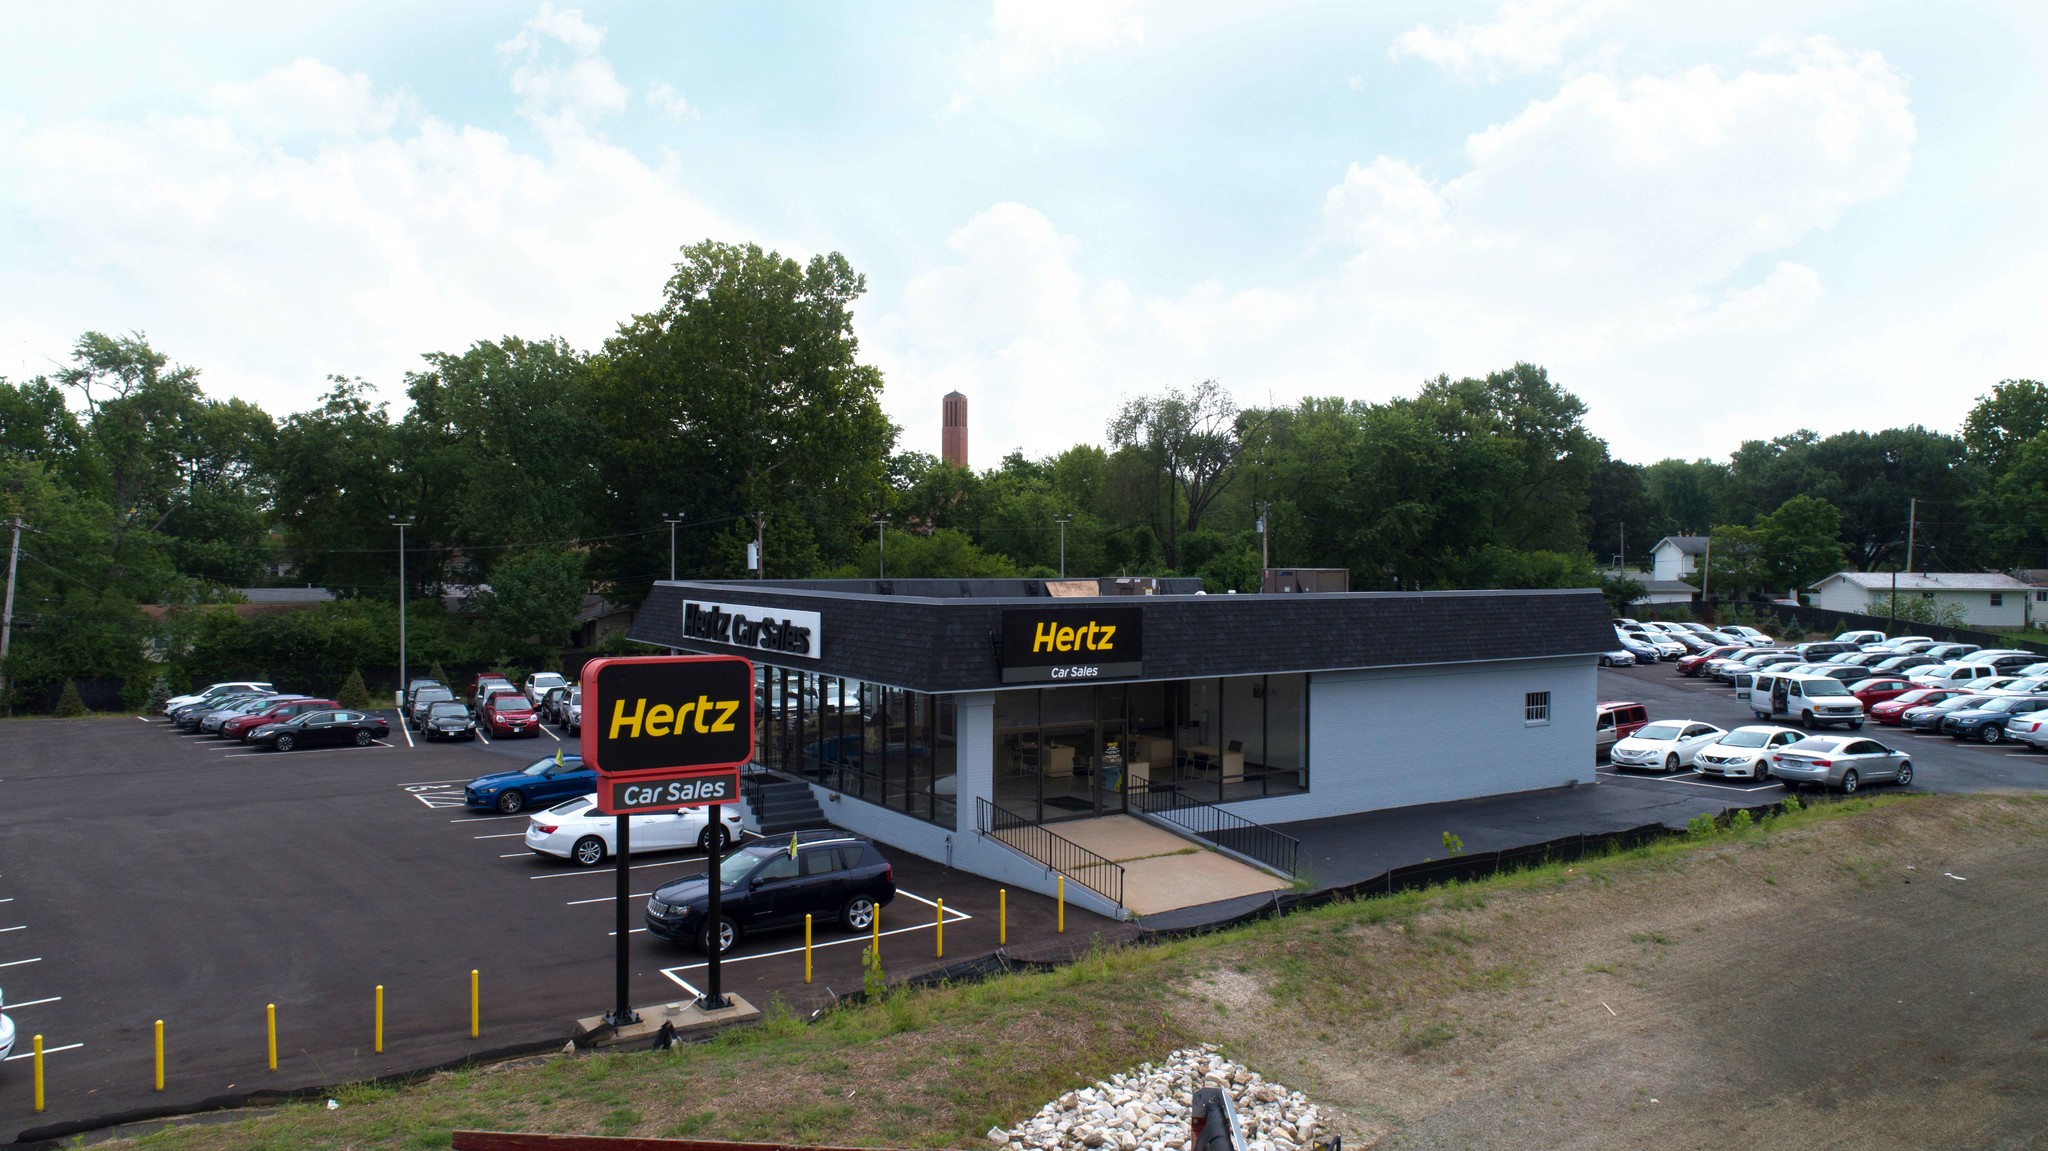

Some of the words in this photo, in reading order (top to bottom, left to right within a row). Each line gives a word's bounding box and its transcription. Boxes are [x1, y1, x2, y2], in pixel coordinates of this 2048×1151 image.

[686, 603, 732, 642] Hertz
[732, 613, 762, 647] Car
[759, 617, 811, 654] Sales
[1033, 621, 1116, 652] Hertz
[1051, 668, 1070, 678] Car
[1071, 666, 1098, 677] Sales
[608, 695, 740, 740] Hertz
[624, 785, 663, 805] Car
[666, 780, 726, 802] Sales
